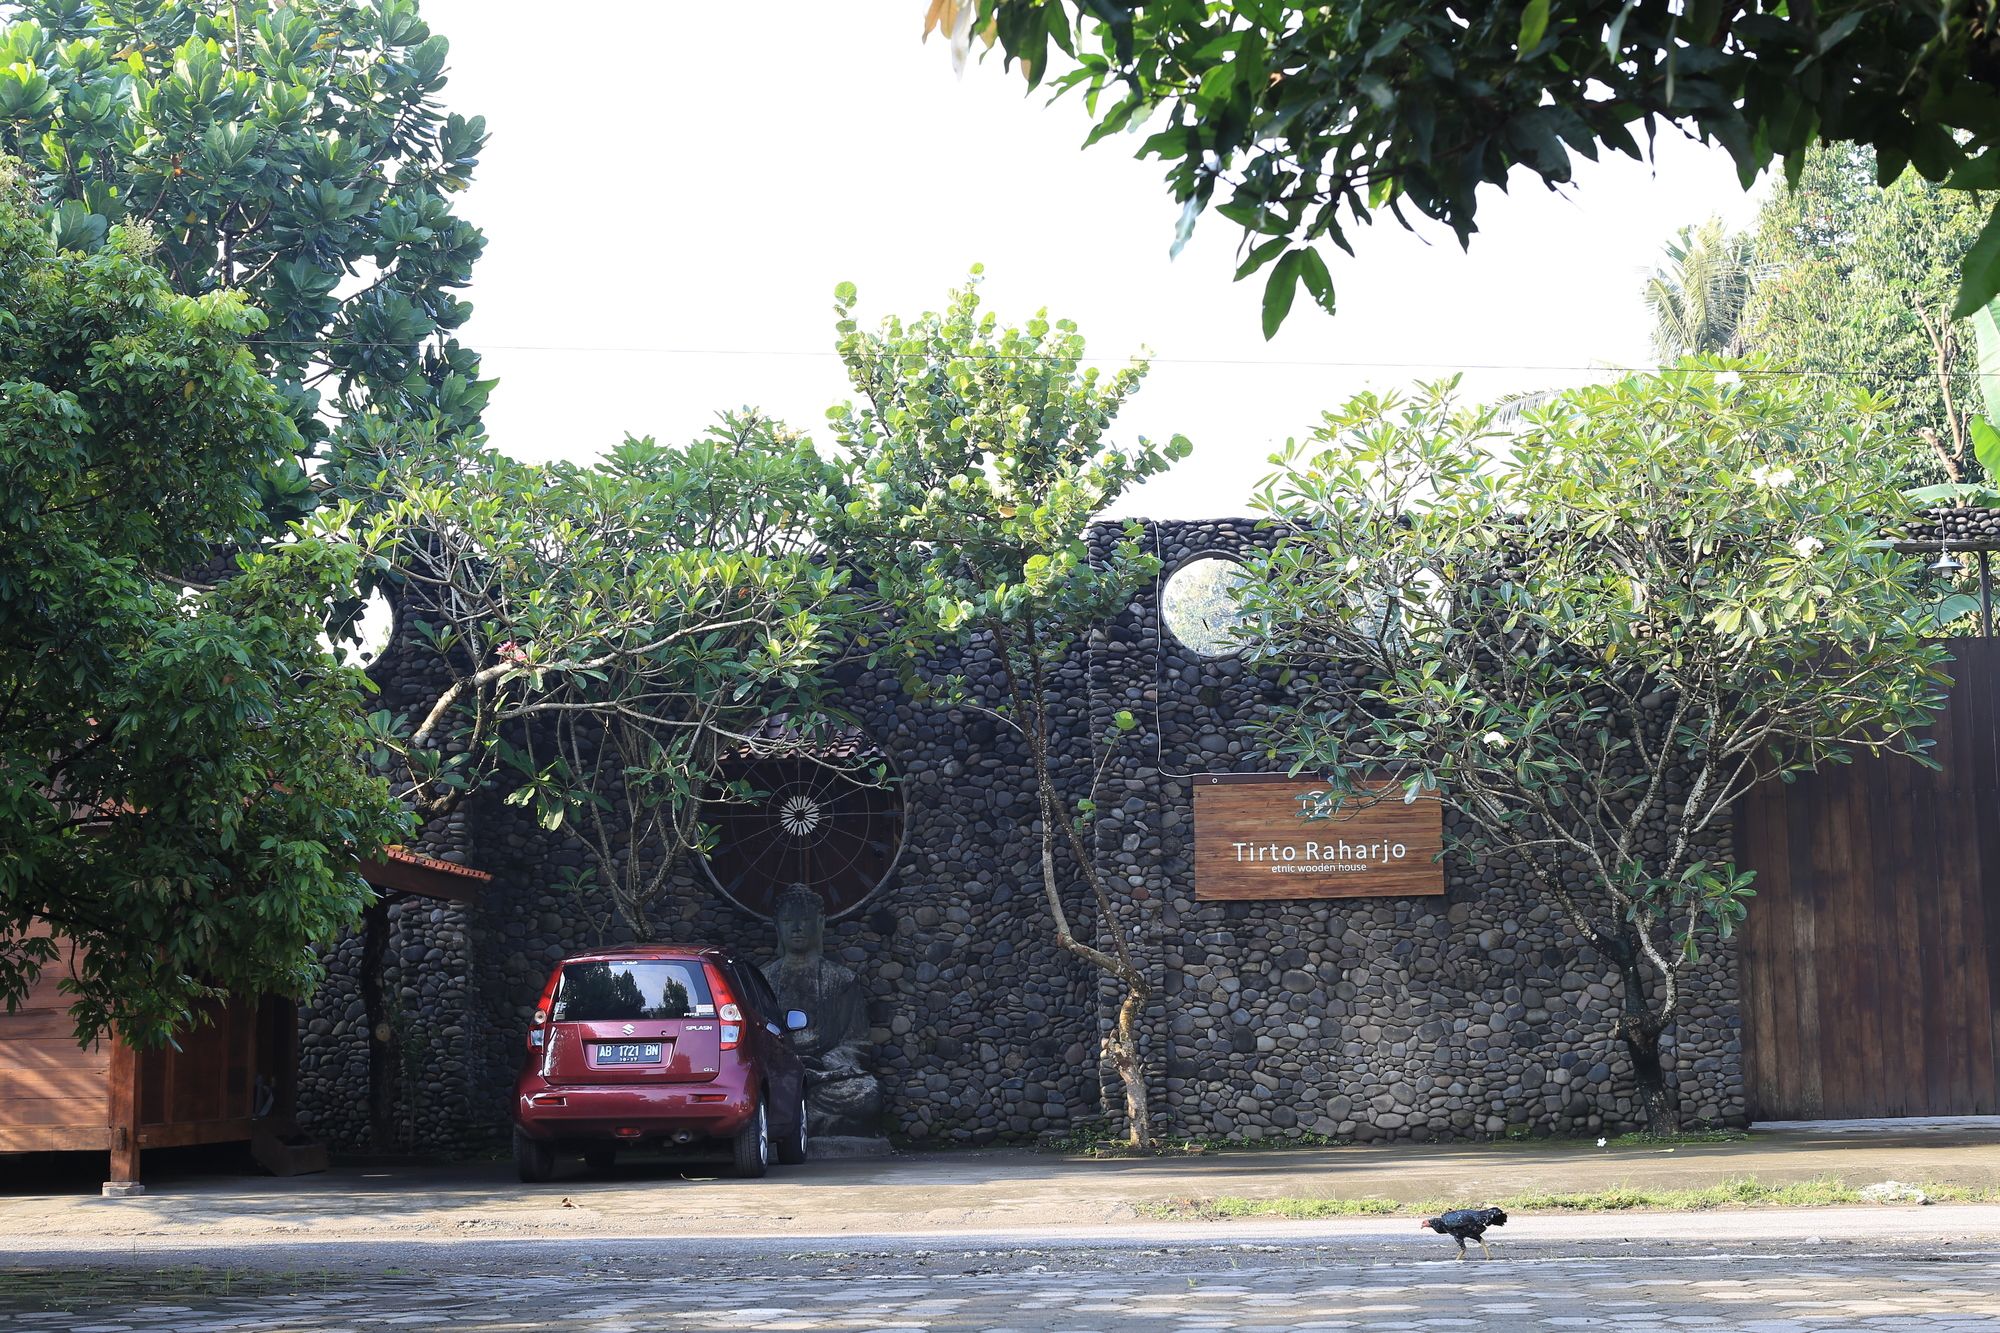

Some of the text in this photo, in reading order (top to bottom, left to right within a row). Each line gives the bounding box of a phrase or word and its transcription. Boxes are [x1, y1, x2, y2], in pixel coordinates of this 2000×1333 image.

[1232, 839, 1407, 864] Tirto Raharjo
[1271, 862, 1367, 873] etnic wooden house
[599, 1044, 659, 1057] AB 1721 BN
